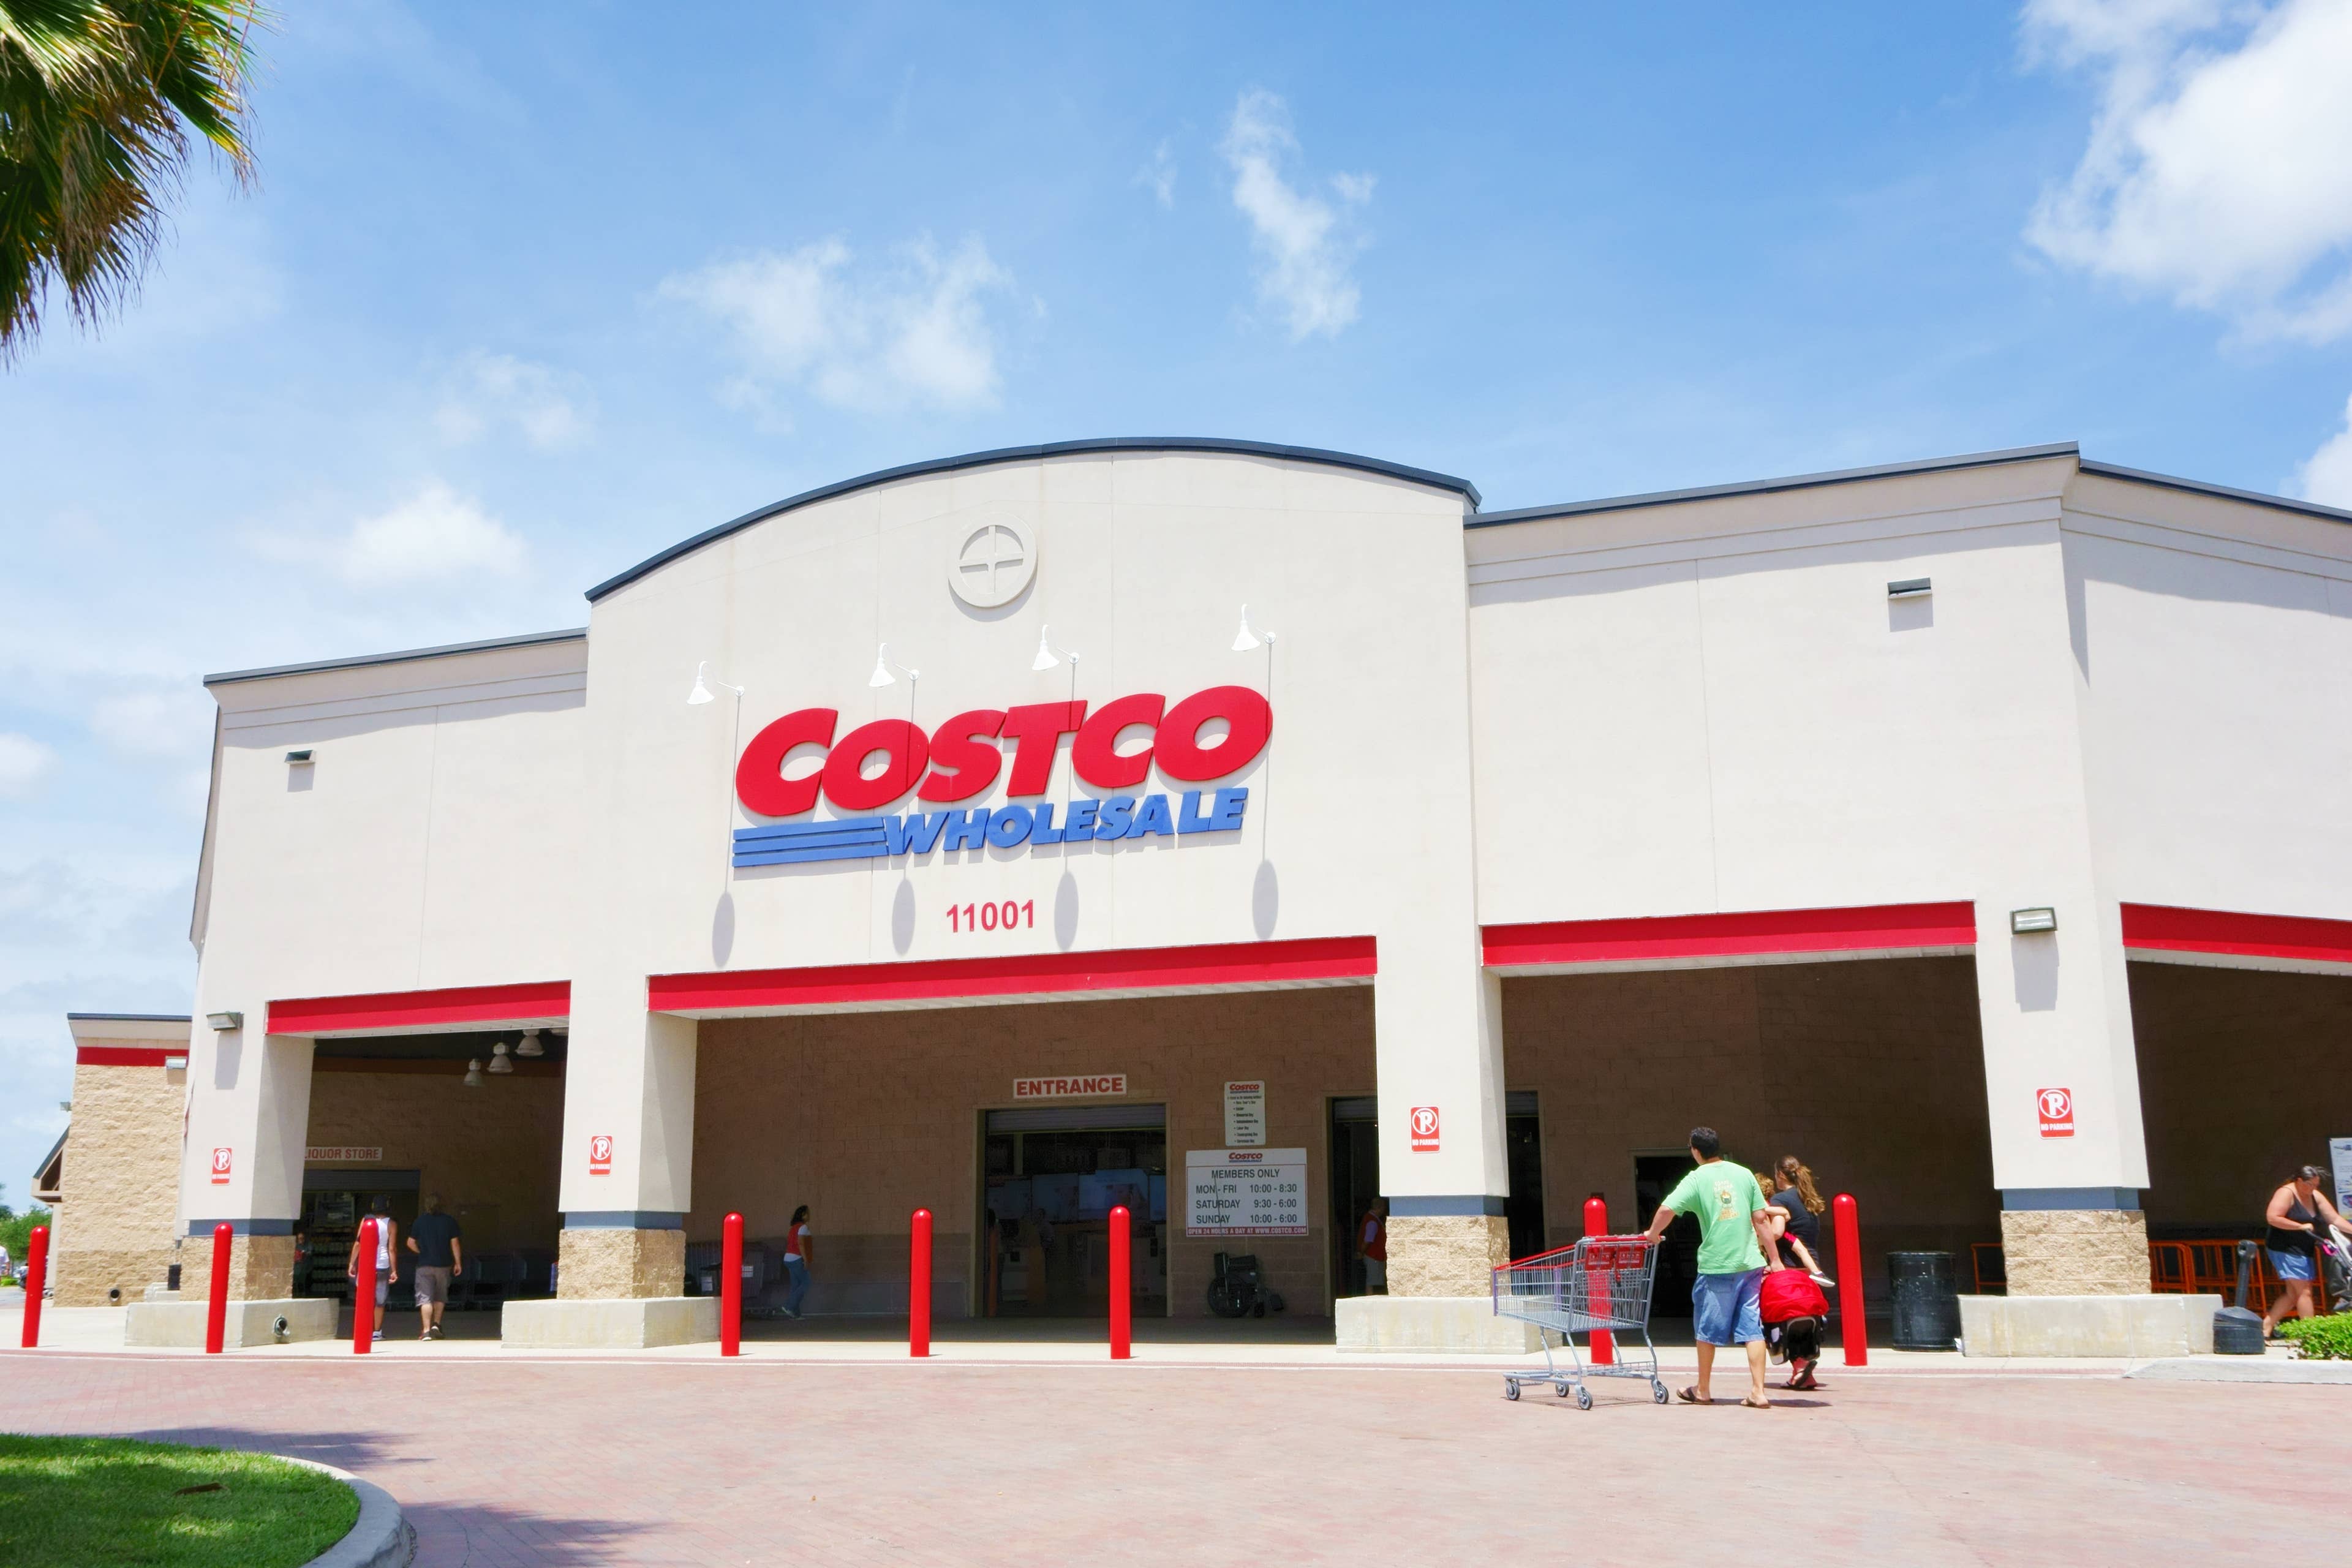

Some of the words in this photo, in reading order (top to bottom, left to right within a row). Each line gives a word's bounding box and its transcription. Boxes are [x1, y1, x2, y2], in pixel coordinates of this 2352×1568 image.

[736, 685, 1273, 816] COSTCO
[883, 788, 1248, 854] WHOLESALE
[946, 899, 1035, 933] 11001
[1016, 1077, 1124, 1095] ENTRANCE
[304, 1148, 341, 1159] IQUOR
[345, 1148, 379, 1159] STORE
[1212, 1170, 1254, 1179] MEMBERS
[1257, 1169, 1280, 1178] ONLY
[1196, 1185, 1215, 1194] MON
[1223, 1185, 1237, 1193] FRI
[1250, 1184, 1272, 1193] 10:00
[1279, 1183, 1297, 1193] 8:30
[1196, 1200, 1240, 1208] SATURDAY
[1254, 1199, 1272, 1208] 9:30
[1279, 1199, 1297, 1208] 6:00
[1196, 1215, 1231, 1224] SUNDAY
[1250, 1215, 1272, 1223] 10:00
[1279, 1214, 1297, 1223] 6:00
